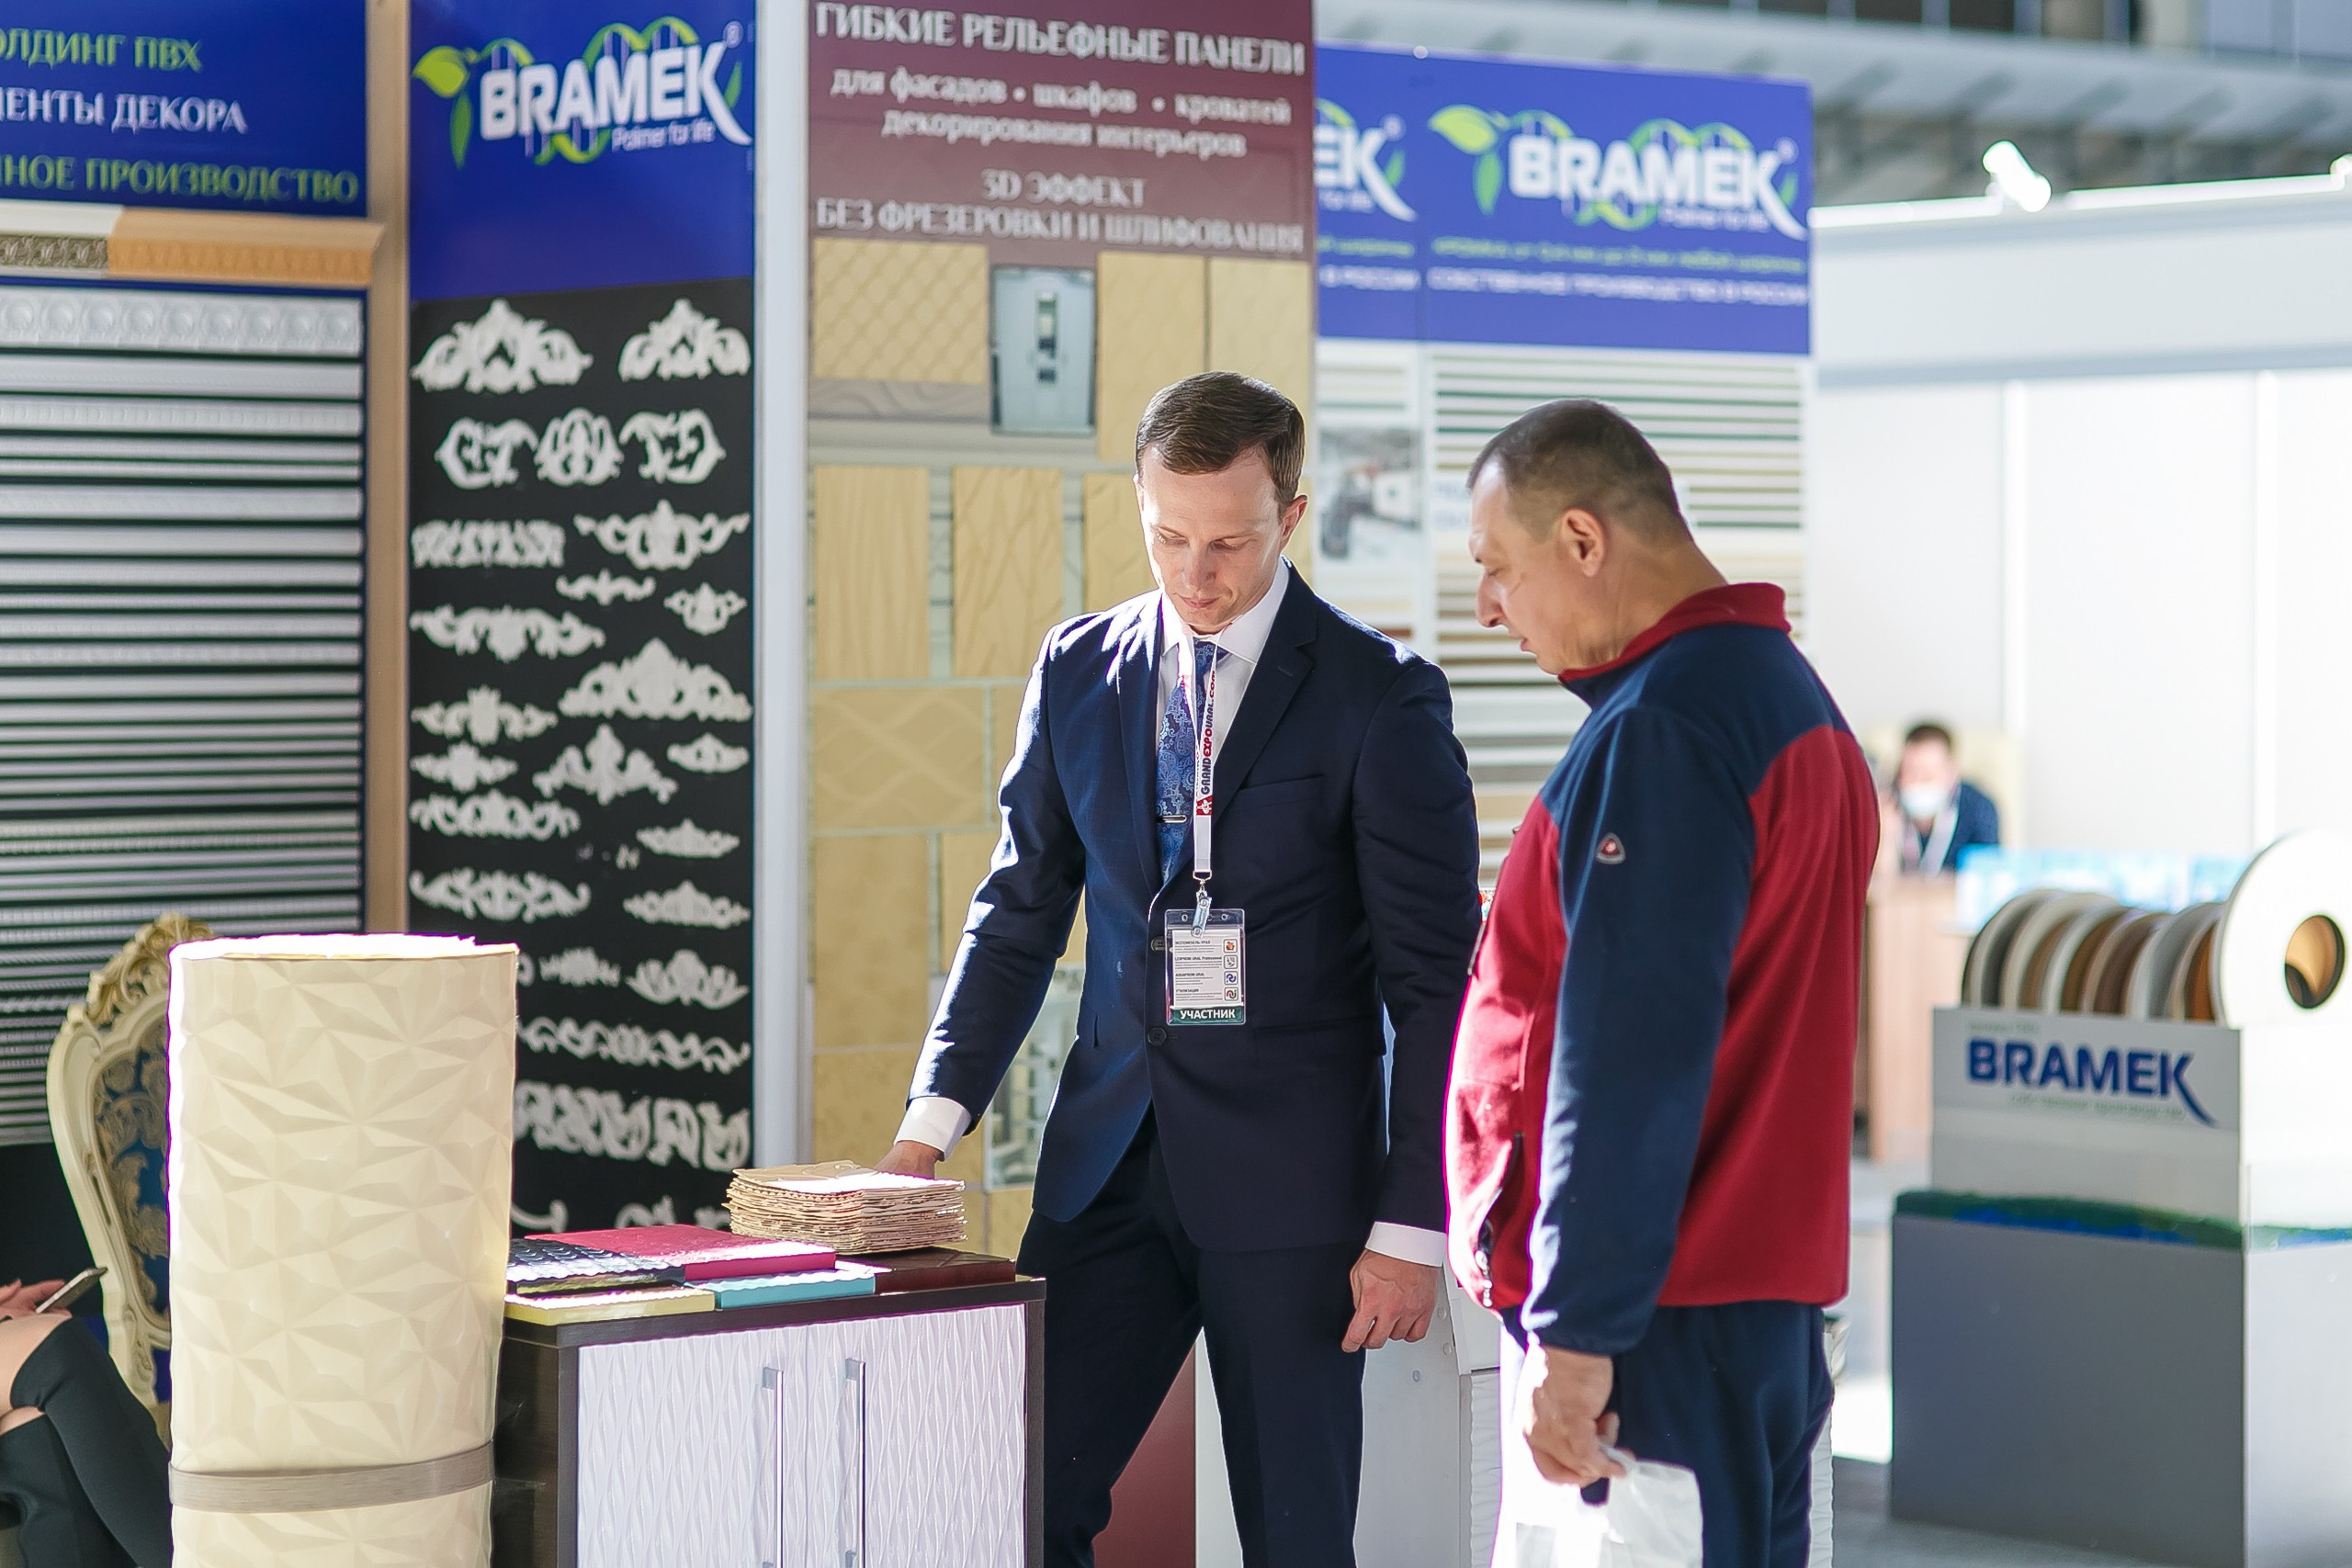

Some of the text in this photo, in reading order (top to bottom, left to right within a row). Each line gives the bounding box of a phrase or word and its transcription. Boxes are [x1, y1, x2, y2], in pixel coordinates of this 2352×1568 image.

[134, 36, 202, 73] ПВХ
[815, 2, 1306, 75] ГИБКИЕ РЕЛЬЕФНЫЕ ПАНЕЛИ
[0, 86, 248, 135] ЕНТЫ ДЕКОРА
[480, 40, 753, 146] BRAMEK
[831, 65, 1292, 126] для фасадов шкафов кроватей
[881, 109, 1248, 161] декорирования интерьеров
[0, 153, 359, 203] НОЕ ПРОИЗВОДСТВО
[979, 168, 1146, 209] 3D ЭФФЕКТ
[1509, 135, 1808, 241] BRAMEK
[816, 197, 874, 230] БЕЗ
[877, 199, 1073, 243] ФРЕЗЕРОВКИ
[1077, 211, 1101, 243] И
[1103, 212, 1304, 254] ШЛИФОВАНИЯ
[1180, 1009, 1236, 1020] УЧАСТНИК
[1966, 1037, 2217, 1127] BRAMEK
